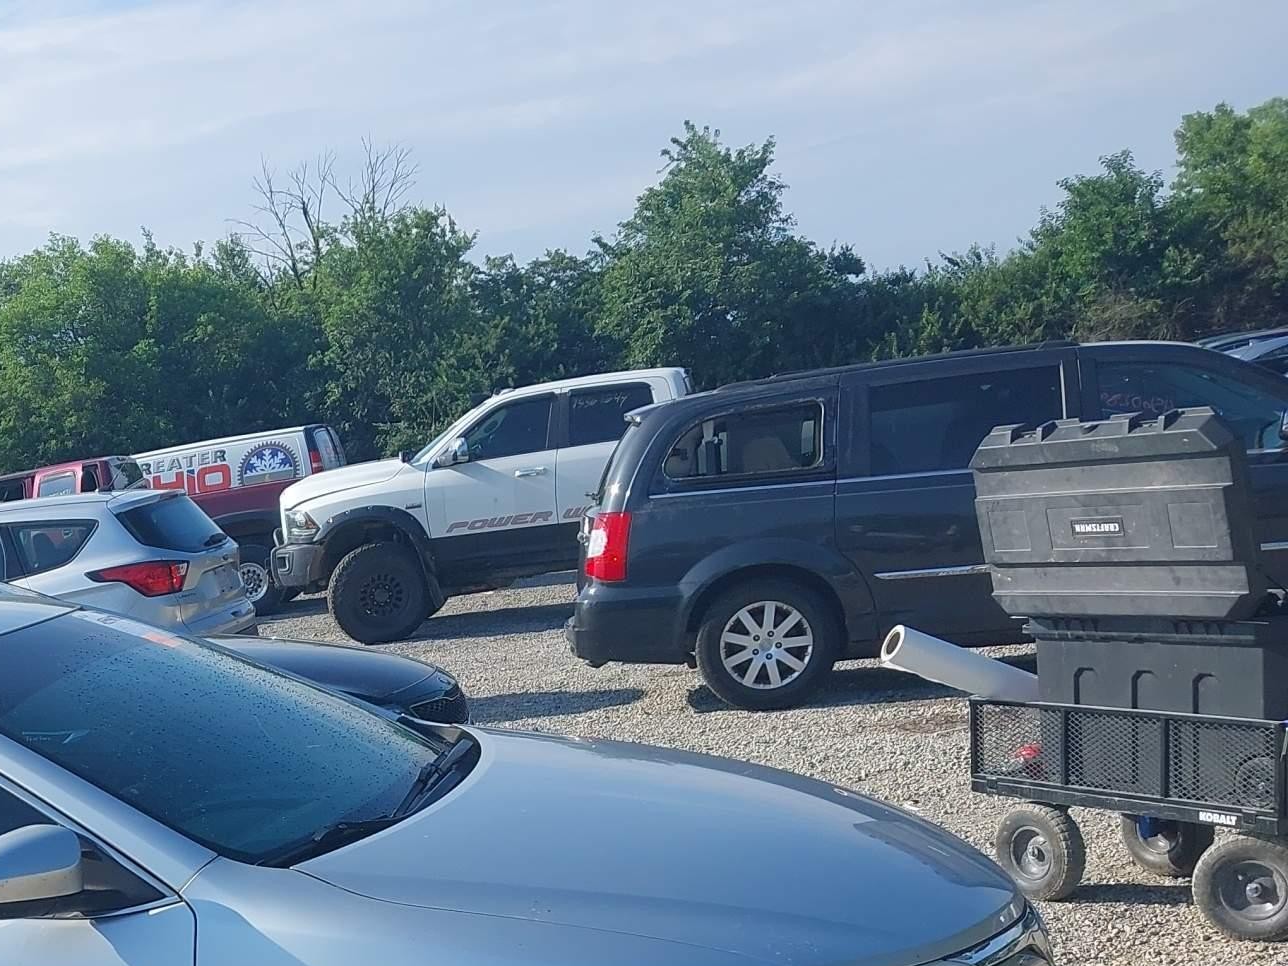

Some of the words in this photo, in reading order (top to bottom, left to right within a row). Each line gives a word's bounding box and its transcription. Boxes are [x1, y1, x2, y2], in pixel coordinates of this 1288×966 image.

[145, 464, 232, 496] HIO
[446, 511, 553, 533] POWER
[1074, 523, 1120, 533] CRAFTSMAN
[1198, 811, 1238, 826] KOBALT
